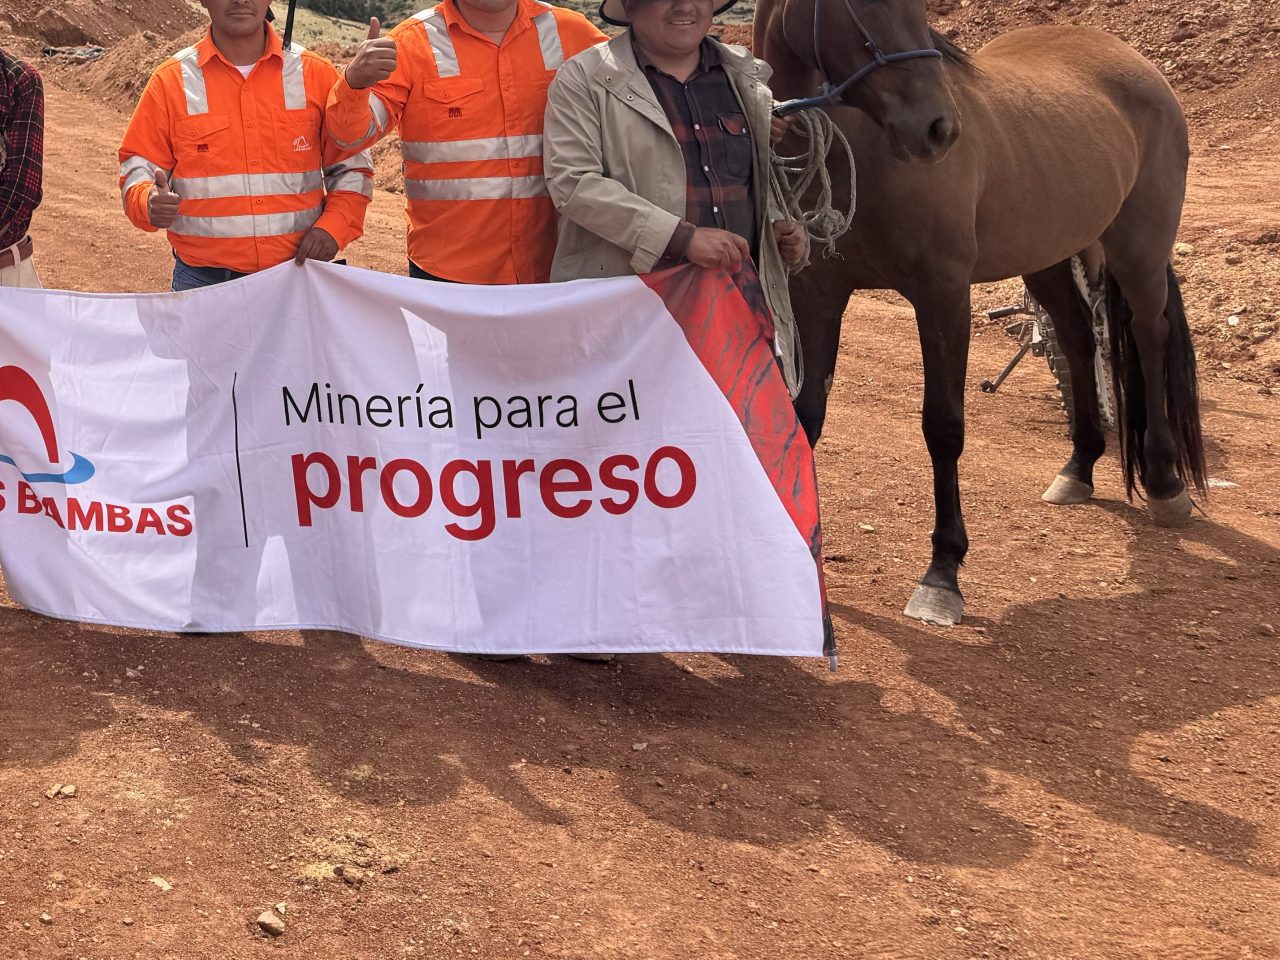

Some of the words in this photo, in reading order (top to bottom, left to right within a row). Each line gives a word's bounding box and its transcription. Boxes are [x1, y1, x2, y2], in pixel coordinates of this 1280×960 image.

[282, 382, 454, 429] Minería
[473, 394, 579, 439] para
[596, 379, 640, 423] el
[17, 480, 193, 538] BAMBAS
[291, 445, 698, 541] progreso
